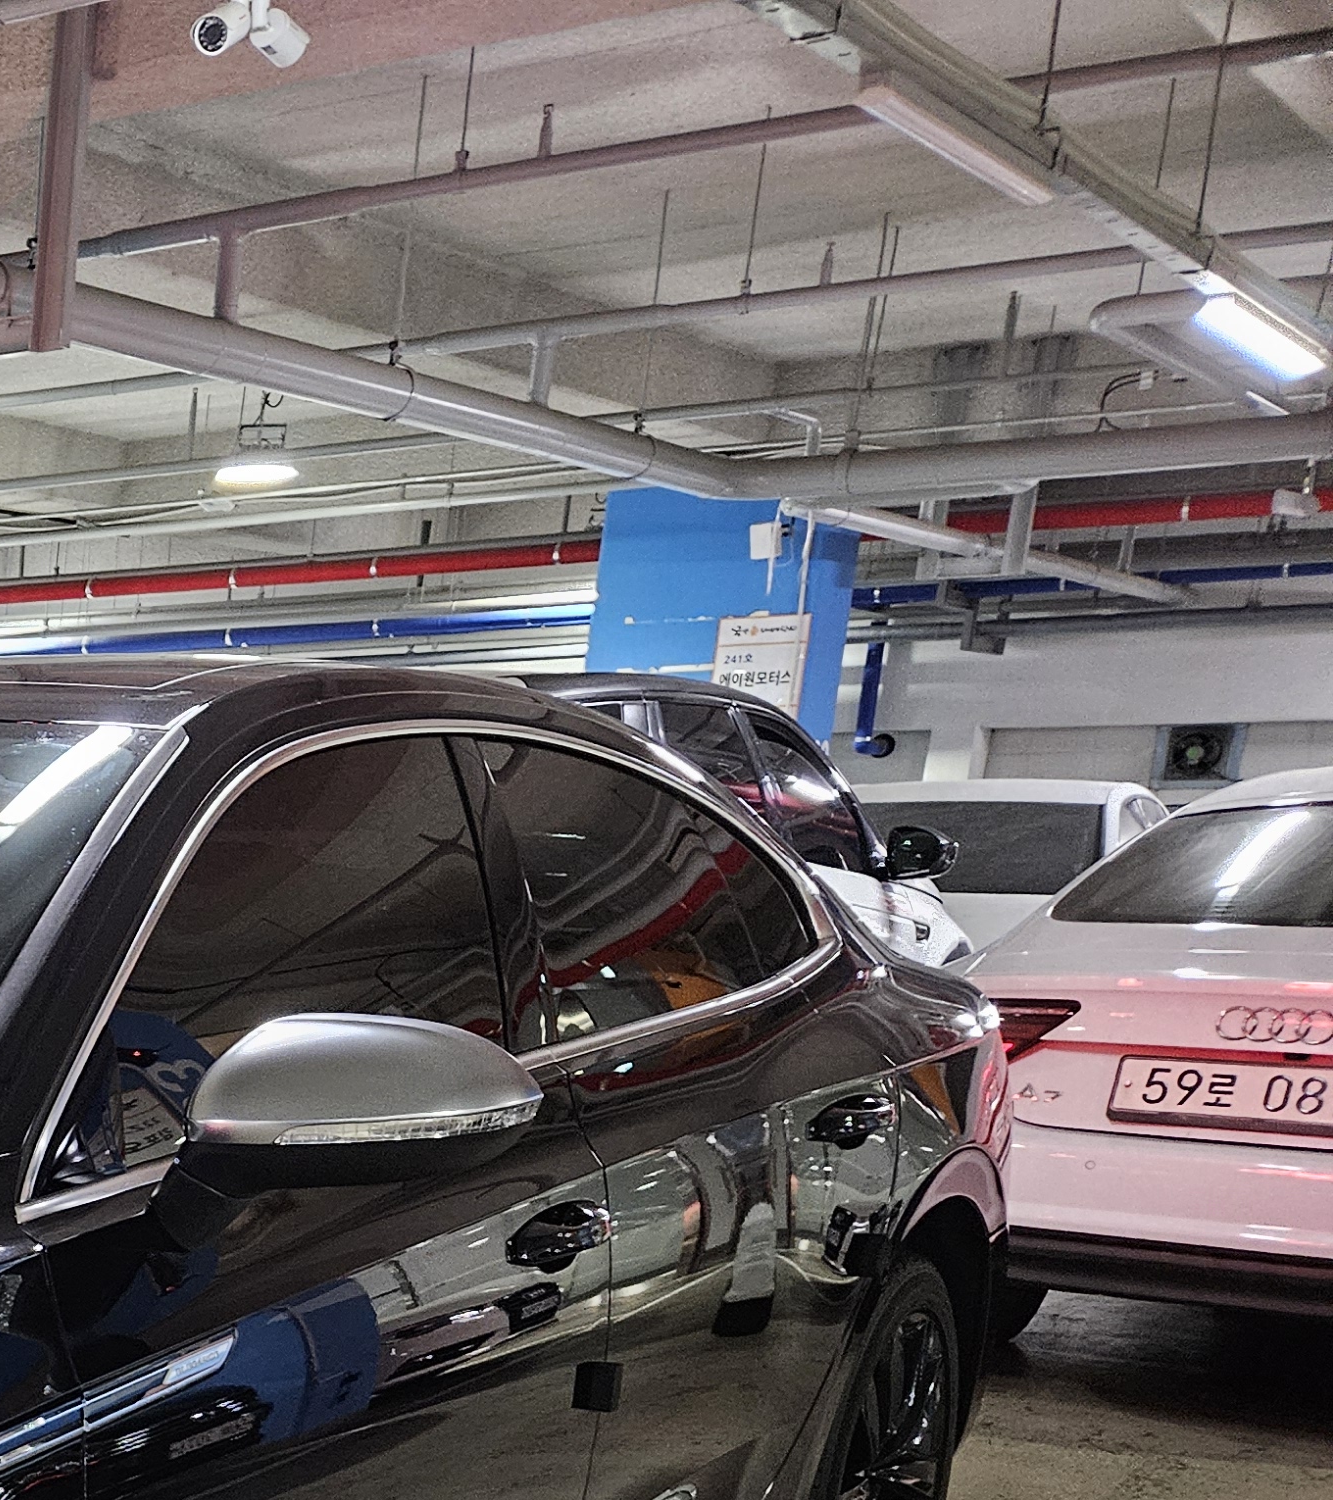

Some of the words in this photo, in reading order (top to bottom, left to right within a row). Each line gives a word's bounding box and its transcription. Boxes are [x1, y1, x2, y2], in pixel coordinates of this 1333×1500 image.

[719, 670, 791, 687] 에이원모터스
[1142, 1067, 1237, 1108] 59로
[1263, 1074, 1328, 1115] 08
